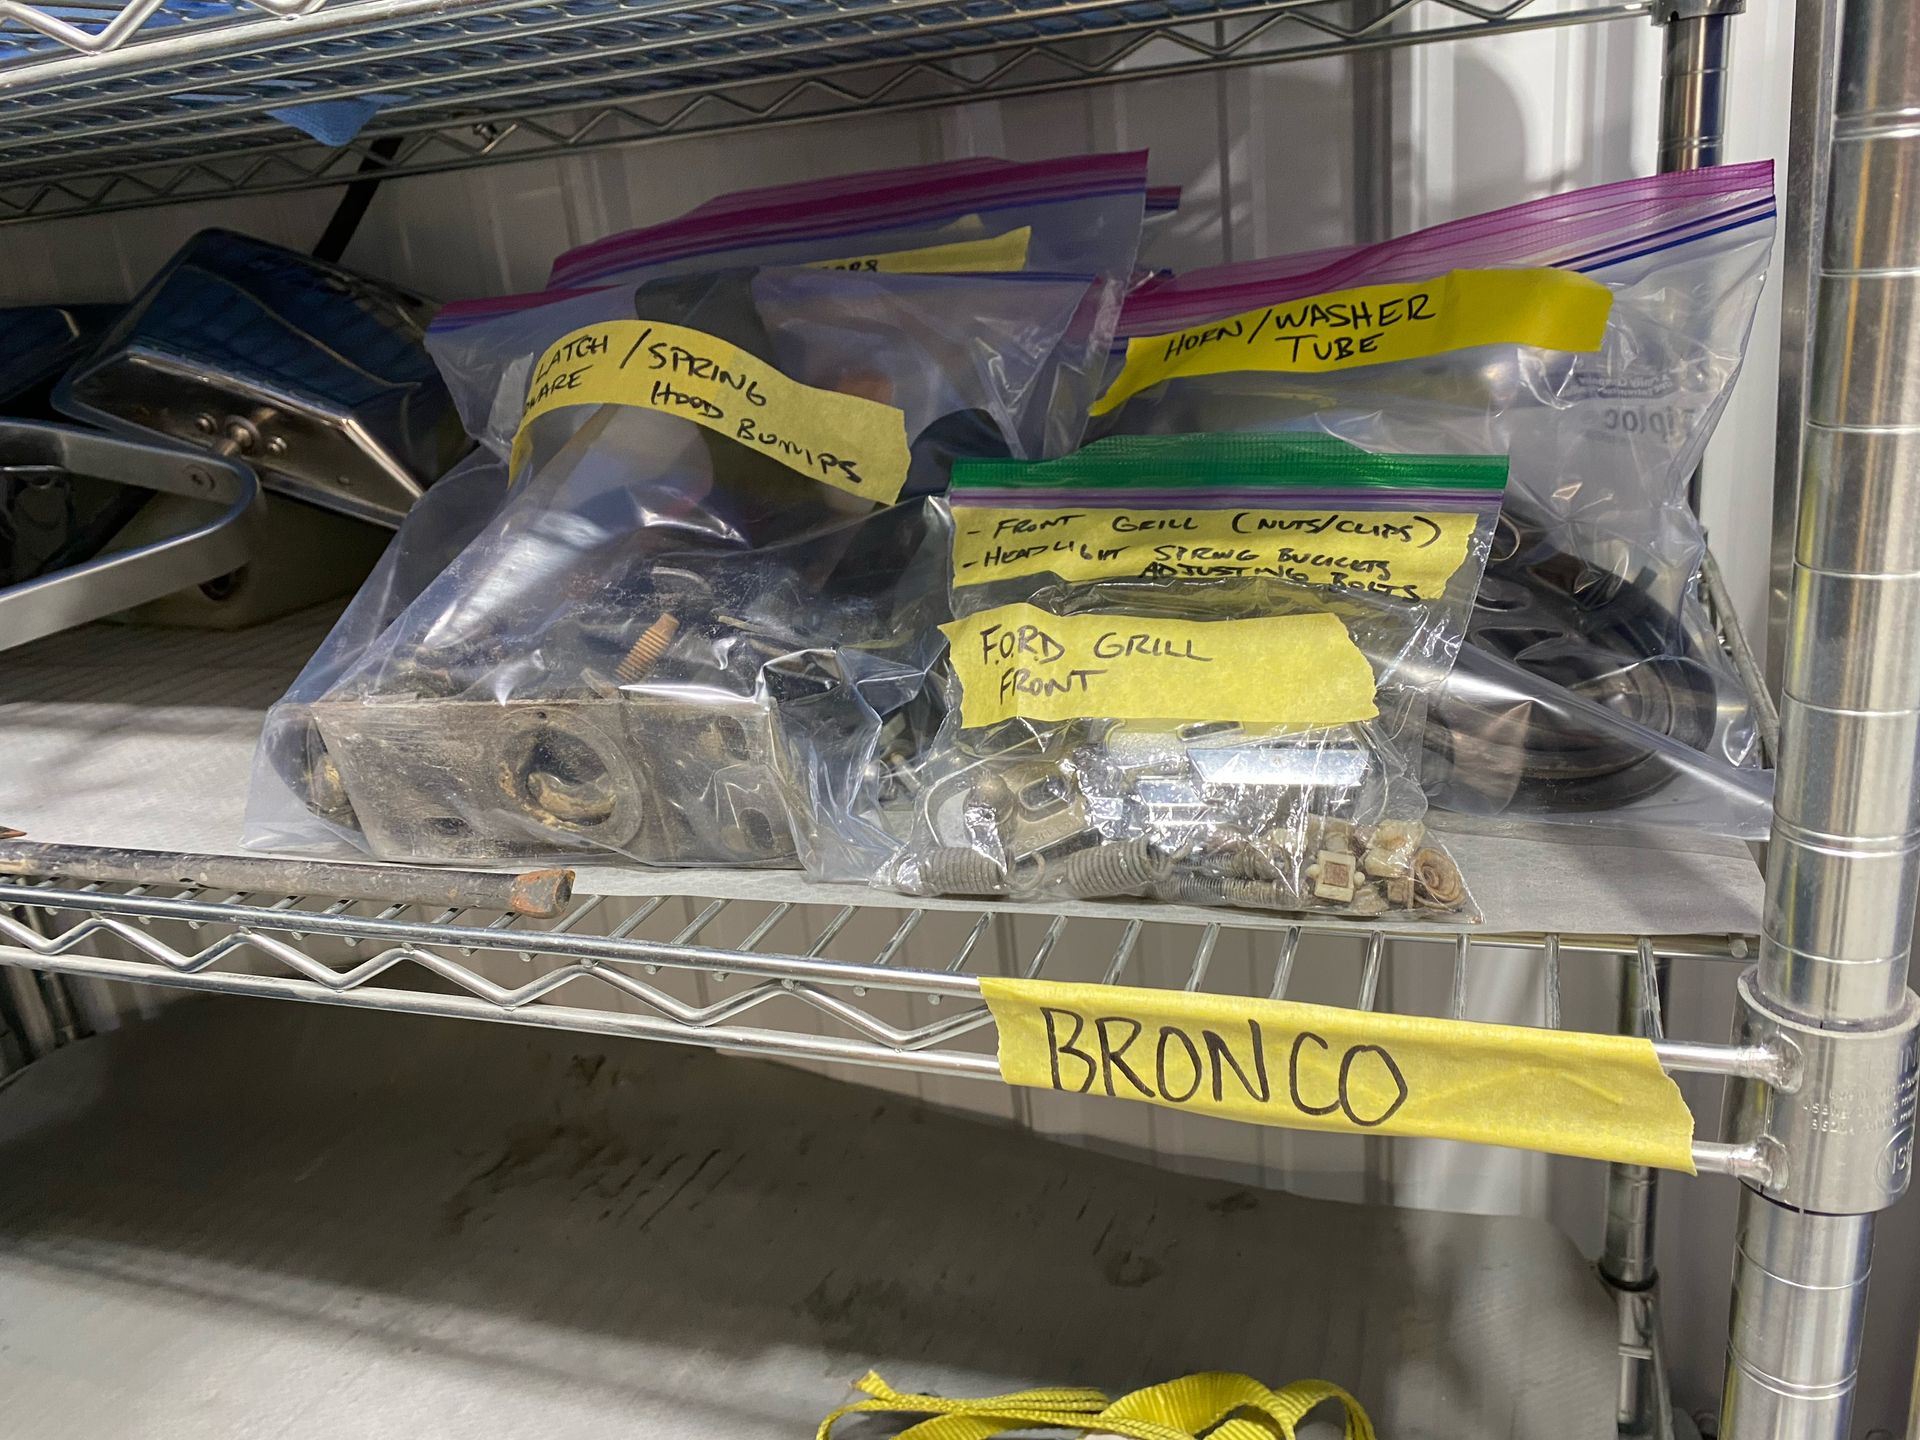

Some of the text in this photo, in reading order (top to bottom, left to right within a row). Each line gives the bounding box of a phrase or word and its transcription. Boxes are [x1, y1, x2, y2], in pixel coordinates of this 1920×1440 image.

[536, 336, 608, 385] LATCH
[1275, 332, 1384, 363] TUBE
[651, 380, 724, 419] HOOD
[993, 514, 1086, 539] FRONT
[1112, 515, 1199, 531] GRILL
[1278, 548, 1391, 581] BUCKETS
[1330, 572, 1421, 603] BOLTS
[1093, 632, 1213, 662] GRILL
[1000, 666, 1109, 706] FRONT
[1039, 1006, 1409, 1127] BRONCO
